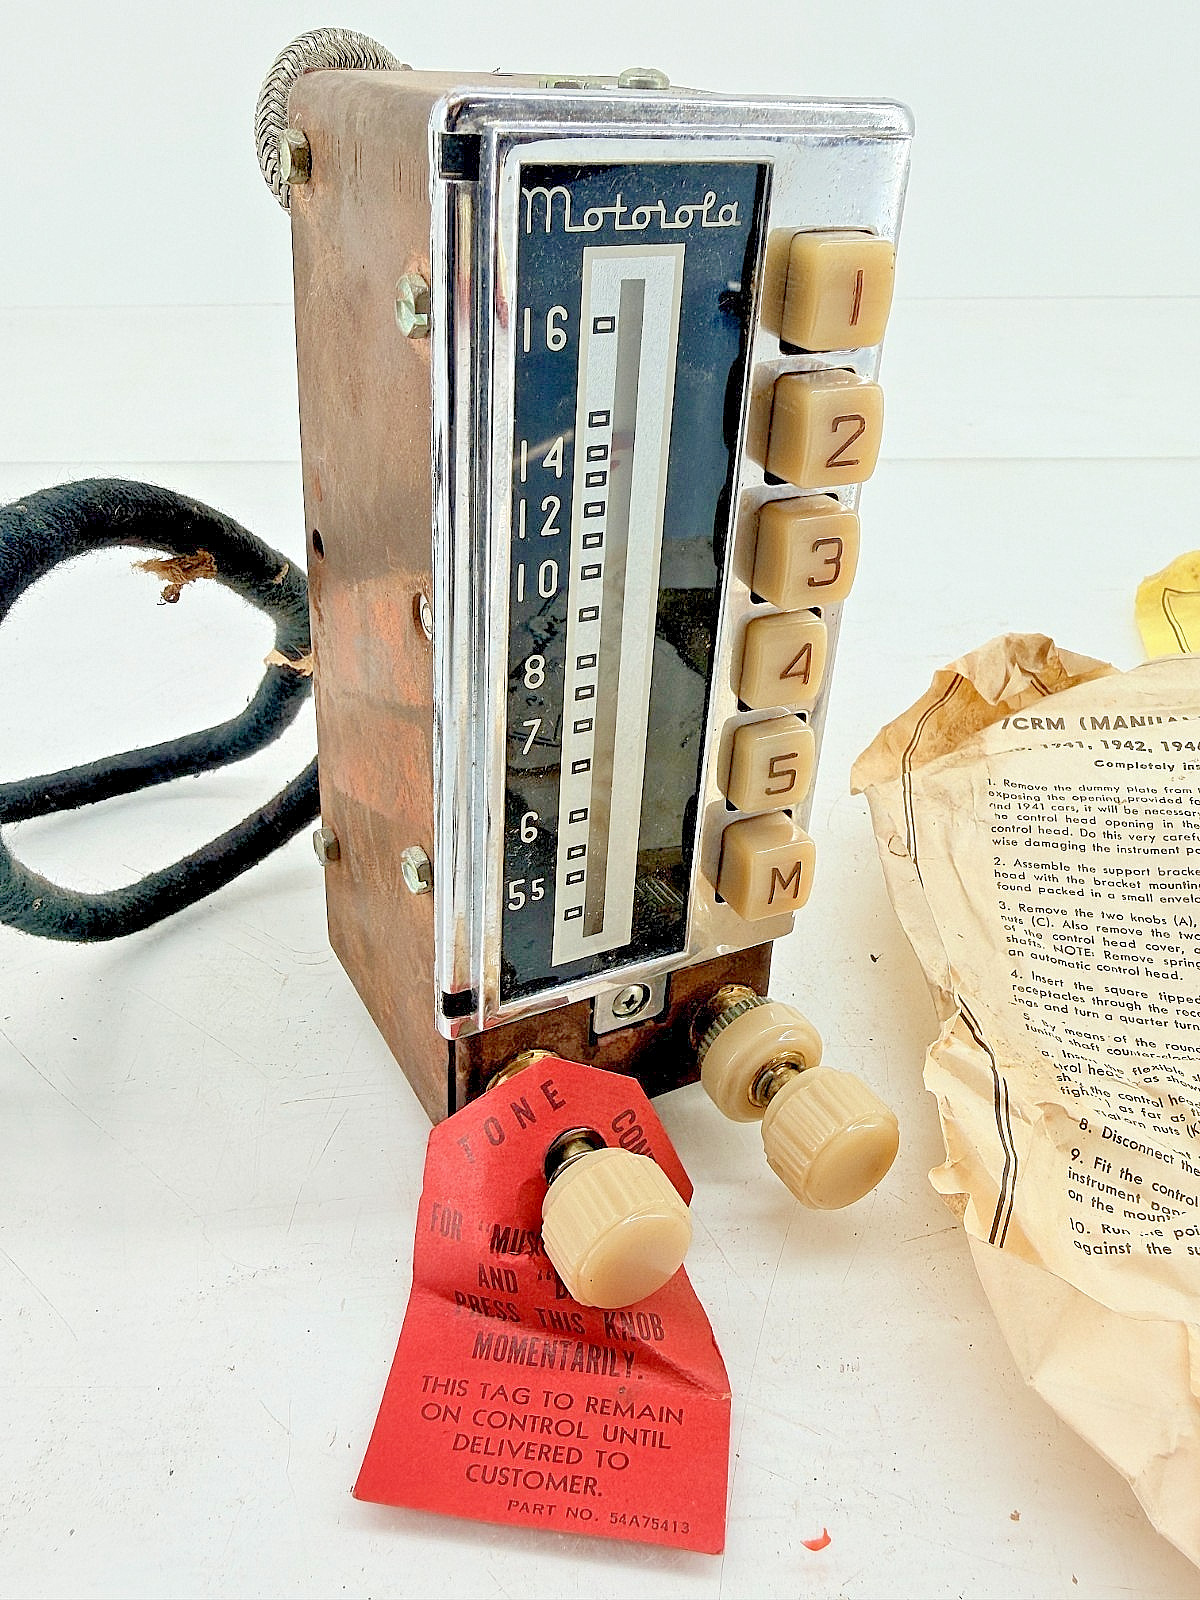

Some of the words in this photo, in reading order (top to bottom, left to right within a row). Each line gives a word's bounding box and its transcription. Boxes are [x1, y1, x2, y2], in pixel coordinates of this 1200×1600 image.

[522, 186, 741, 233] Motorola
[849, 270, 863, 326] 1
[523, 304, 569, 353] 16
[825, 414, 866, 469] 2
[520, 436, 564, 482] 14
[519, 495, 561, 539] 12
[807, 539, 843, 588] 3
[516, 560, 558, 602] 10
[523, 655, 546, 689] 8
[779, 642, 813, 686] 4
[522, 717, 542, 755] 7
[1100, 740, 1153, 753] 1942,
[765, 752, 797, 795] 5
[1093, 760, 1175, 772] Completely
[987, 778, 996, 786] 1.
[1003, 778, 1048, 791] Remove
[1053, 784, 1072, 792] the
[1078, 784, 1120, 793] dummy
[1126, 785, 1158, 793] plate
[1163, 786, 1192, 794] from
[988, 790, 1041, 802] exposing
[1071, 794, 1120, 805] opening
[1127, 796, 1183, 804] provided
[1016, 813, 1058, 822] control
[1065, 814, 1097, 825] head
[1105, 819, 1154, 830] opening
[1162, 819, 1174, 828] in
[1017, 802, 1045, 811] 1941
[1051, 804, 1079, 813] cars,
[1084, 804, 1092, 812] it
[1097, 804, 1118, 813] will
[1123, 805, 1139, 815] be
[519, 812, 539, 843] 6
[990, 825, 1032, 834] control
[1037, 825, 1073, 836] head.
[1079, 828, 1096, 838] Do
[1102, 830, 1122, 840] this
[1128, 834, 1156, 843] very
[992, 836, 1018, 847] wise
[1024, 837, 1086, 853] damaging
[1092, 842, 1111, 853] the
[1116, 844, 1180, 855] instrument
[993, 856, 1006, 866] 2.
[1013, 858, 1071, 872] Assemble
[1077, 863, 1096, 873] the
[1102, 867, 1150, 877] support
[994, 869, 1026, 880] head
[1033, 873, 1059, 883] with
[1066, 874, 1085, 885] the
[1093, 876, 1141, 889] bracket
[1148, 880, 1200, 890] mountin
[768, 861, 801, 905] M
[996, 881, 1032, 892] found
[1038, 886, 1085, 897] packed
[1090, 888, 1102, 898] in
[1121, 893, 1153, 903] small
[998, 900, 1011, 911] 3.
[1018, 902, 1068, 916] Remove
[1074, 908, 1094, 918] the
[1100, 910, 1124, 921] two
[1130, 912, 1167, 925] knobs
[1173, 914, 1197, 928] (A),
[1000, 915, 1024, 924] nuts
[1031, 915, 1055, 928] (C).
[1062, 919, 1089, 931] Also
[1096, 925, 1143, 936] remove
[1150, 928, 1171, 939] the
[1003, 924, 1016, 932] of
[1023, 929, 1043, 940] the
[1052, 933, 1095, 945] control
[1102, 936, 1136, 949] head
[1145, 943, 1185, 955] cover,
[1053, 944, 1095, 957] NOTE:
[1103, 949, 1154, 964] Remove
[1008, 949, 1024, 957] an
[1030, 952, 1091, 971] automatic
[1096, 963, 1140, 976] control
[1144, 966, 1184, 981] head.
[1010, 969, 1023, 979] 4.
[1031, 970, 1064, 987] Insert
[1073, 981, 1094, 992] the
[1104, 985, 1148, 999] square
[1012, 984, 1086, 1003] receptacles
[1091, 996, 1142, 1011] through
[1148, 1003, 1169, 1014] the
[1044, 1004, 1069, 1014] and
[1074, 1006, 1100, 1019] turn
[1104, 1013, 1113, 1021] a
[1119, 1014, 1169, 1027] quarter
[1064, 1028, 1105, 1042] means
[1113, 1035, 1127, 1043] of
[1135, 1037, 1157, 1048] the
[1068, 1038, 1100, 1052] shaft
[1132, 1063, 1185, 1077] flexible
[1143, 1075, 1160, 1083] as
[1090, 1085, 1111, 1098] the
[1118, 1093, 1164, 1108] control
[456, 1079, 567, 1164] TONE
[611, 1109, 656, 1161] CON
[1118, 1105, 1134, 1114] as
[1140, 1107, 1162, 1120] far
[1170, 1113, 1186, 1123] as
[1079, 1117, 1092, 1134] 8.
[1101, 1125, 1175, 1164] Disconnect
[1152, 1125, 1180, 1136] nuts
[1068, 1166, 1141, 1204] instrument
[1070, 1148, 1084, 1164] 9.
[1093, 1156, 1112, 1174] Fit
[1119, 1167, 1143, 1185] the
[1151, 1182, 1199, 1208] control
[1068, 1189, 1083, 1203] on
[1091, 1196, 1114, 1213] the
[430, 1202, 463, 1241] FOR
[1069, 1217, 1091, 1234] 10.
[1101, 1223, 1131, 1235] Run
[1073, 1240, 1132, 1256] against
[1146, 1241, 1172, 1255] the
[478, 1263, 519, 1294] AND
[454, 1289, 521, 1323] PRESS
[534, 1307, 586, 1335] THIS
[603, 1311, 665, 1343] KNOB
[471, 1330, 644, 1380] MOMENTARILY.
[421, 1375, 470, 1397] THIS
[480, 1382, 531, 1406] TAG
[542, 1390, 574, 1411] TO
[585, 1395, 684, 1426] REMAIN
[420, 1402, 462, 1424] ON
[472, 1408, 589, 1440] CONTROL
[602, 1424, 672, 1450] UNTIL
[452, 1433, 583, 1466] DELIVERED
[596, 1449, 630, 1471] TO
[465, 1463, 603, 1497] CUSTOMER.
[507, 1500, 557, 1516] PART
[565, 1507, 600, 1522] NO.
[609, 1511, 690, 1535] 54A75413
